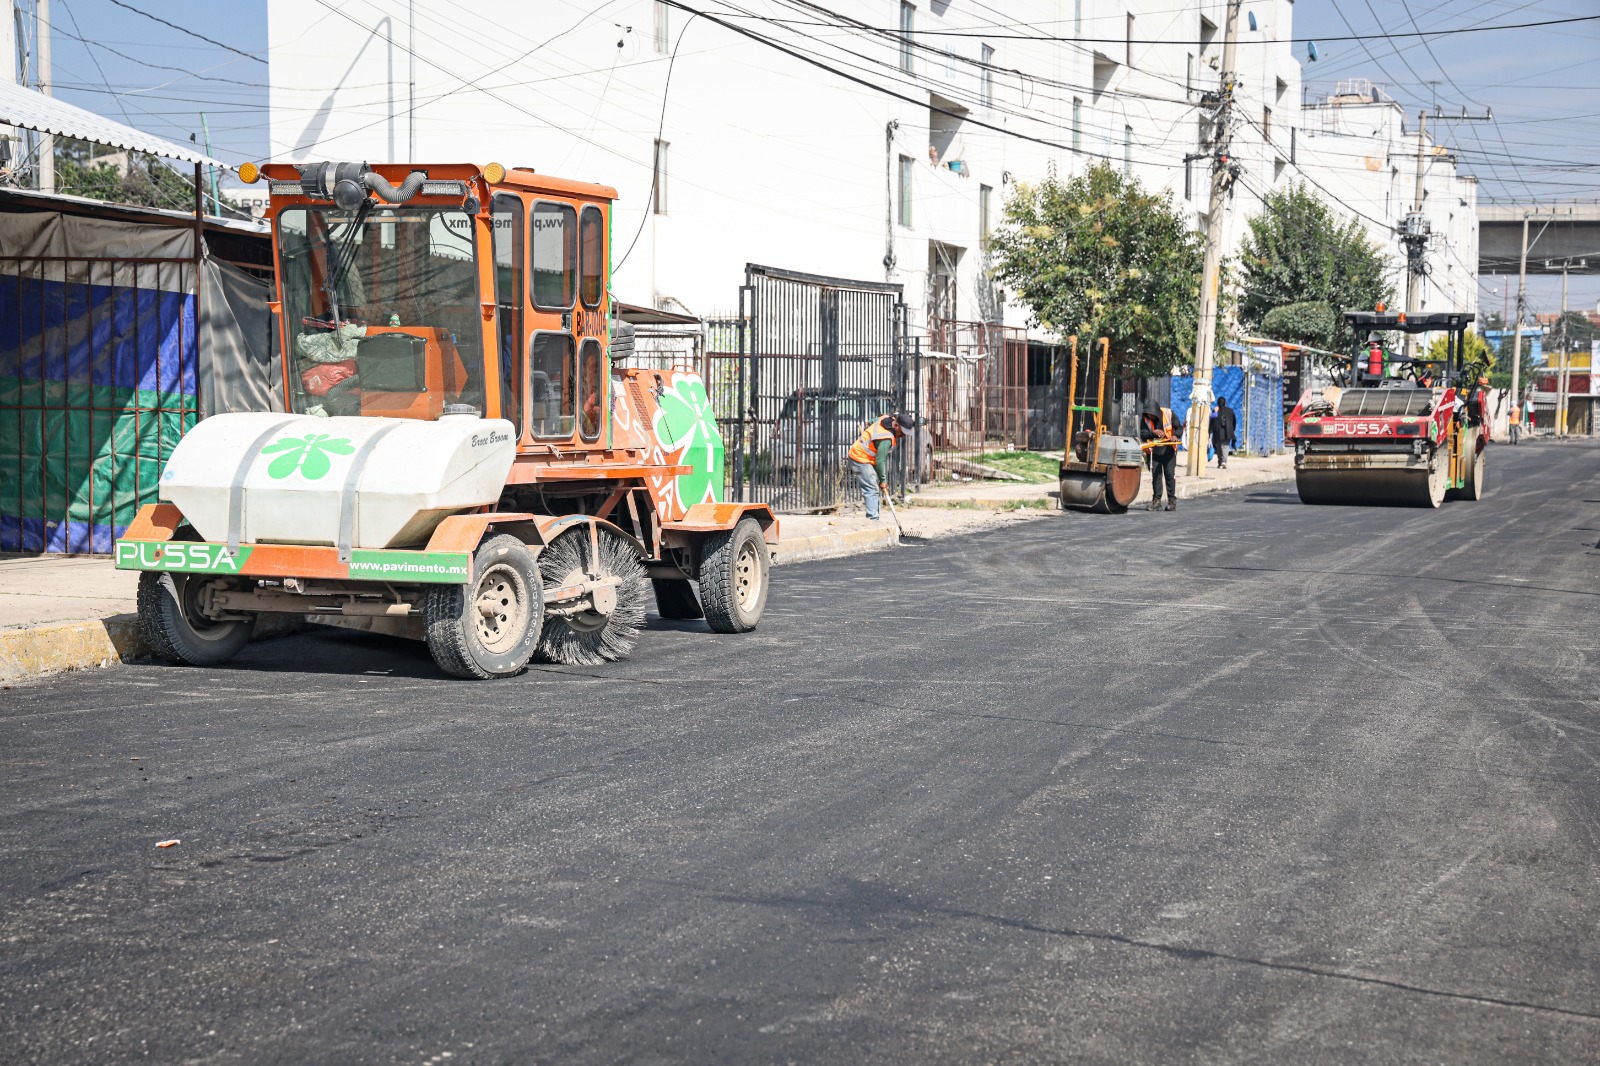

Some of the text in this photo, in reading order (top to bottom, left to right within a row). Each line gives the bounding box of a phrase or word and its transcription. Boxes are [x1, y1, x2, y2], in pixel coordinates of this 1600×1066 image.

[1334, 423, 1392, 435] PUSSA
[116, 542, 237, 570] PUSSA
[349, 562, 468, 575] www.pavimento.mx
